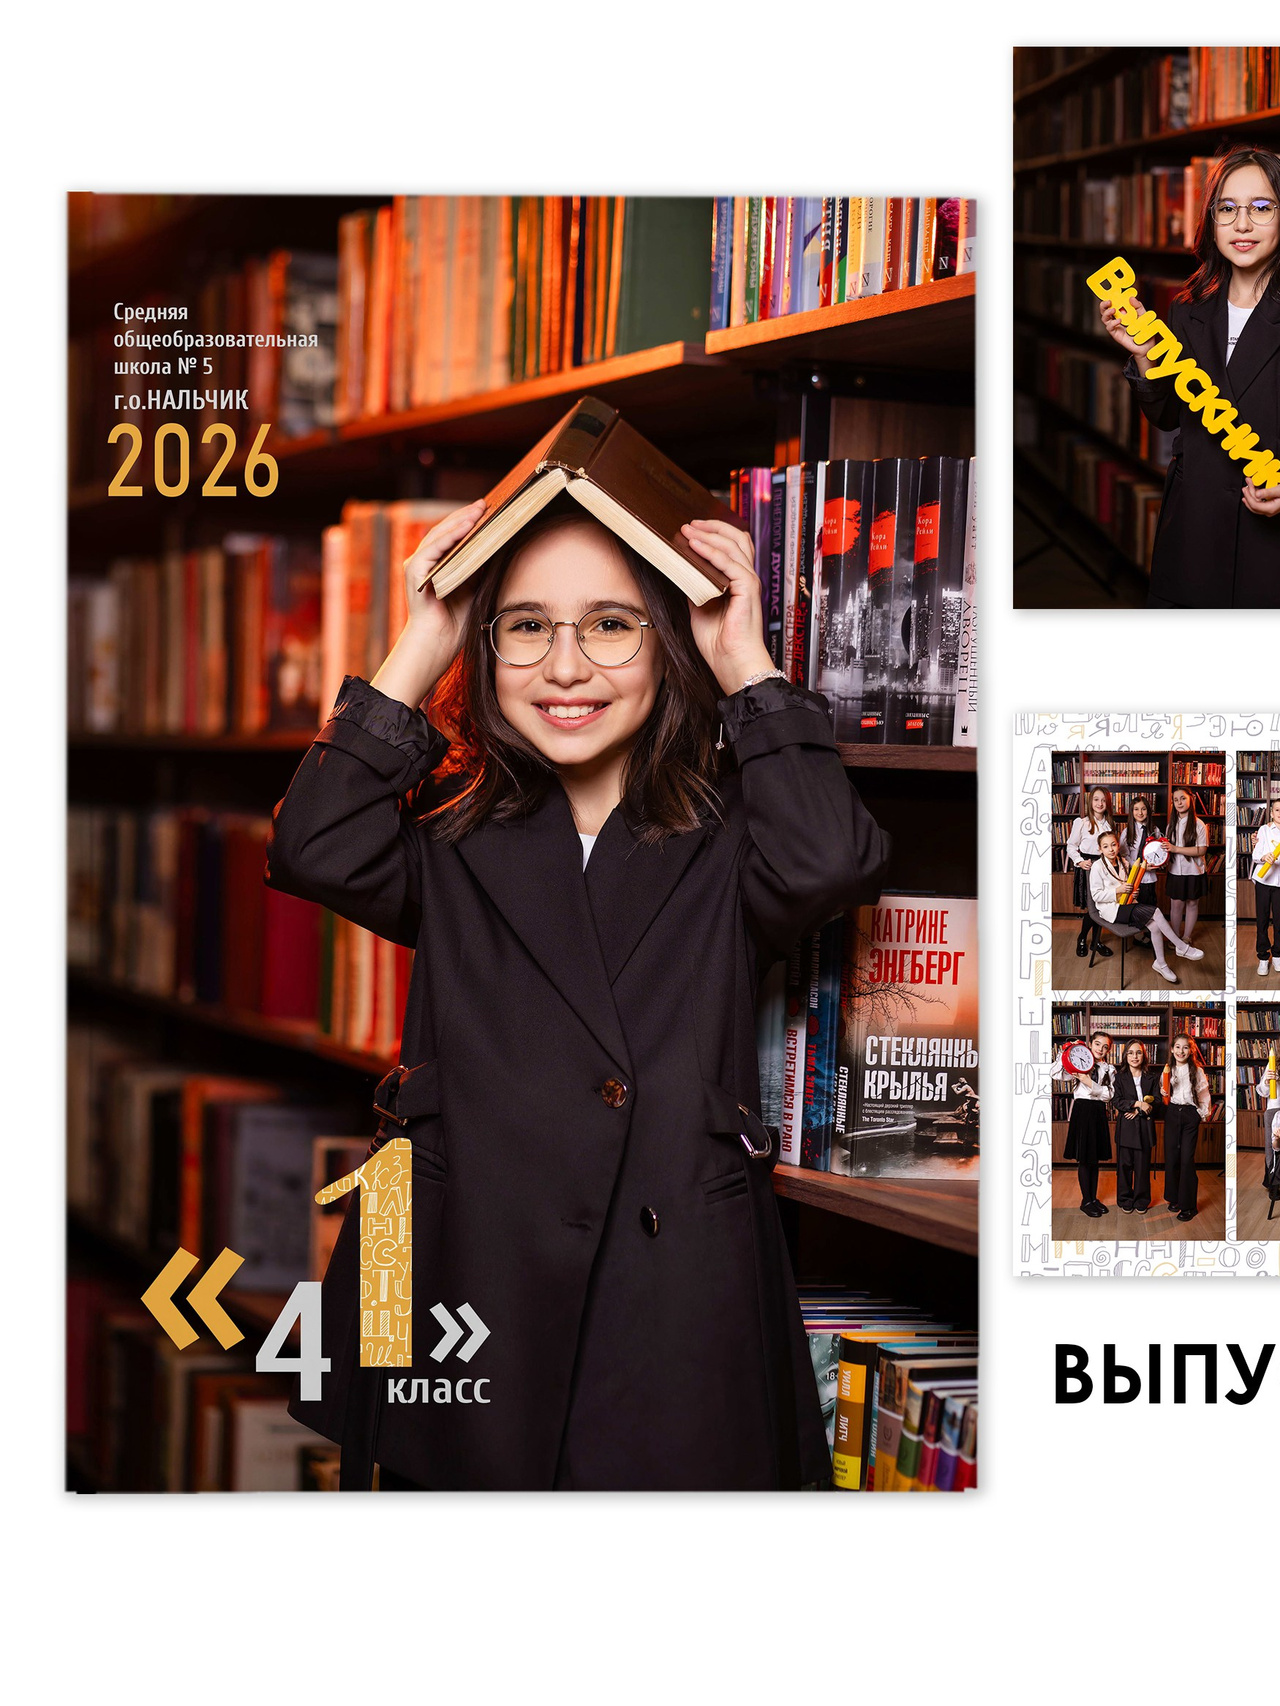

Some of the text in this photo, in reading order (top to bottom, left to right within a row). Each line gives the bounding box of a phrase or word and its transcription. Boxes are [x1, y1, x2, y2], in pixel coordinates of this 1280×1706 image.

[824, 517, 837, 525] Кора
[872, 532, 886, 540] Кора
[918, 516, 932, 525] Кора
[770, 552, 783, 616] ДУГЛАС
[871, 907, 949, 945] КАТРИНЕ
[869, 948, 965, 986] ЭНГБЕРГ
[784, 1029, 798, 1110] ВСТРЕТИМСЯ
[804, 1043, 817, 1106] ТЬМА ЗНАЕТ
[835, 1066, 849, 1135] СТЕКЛЯННЫЕ
[863, 1070, 948, 1102] КРЫЛЬЯ
[781, 1124, 793, 1153] РАЮ
[842, 1370, 851, 1397] УИЛЛ
[838, 1414, 849, 1442] ЛИТЧ
